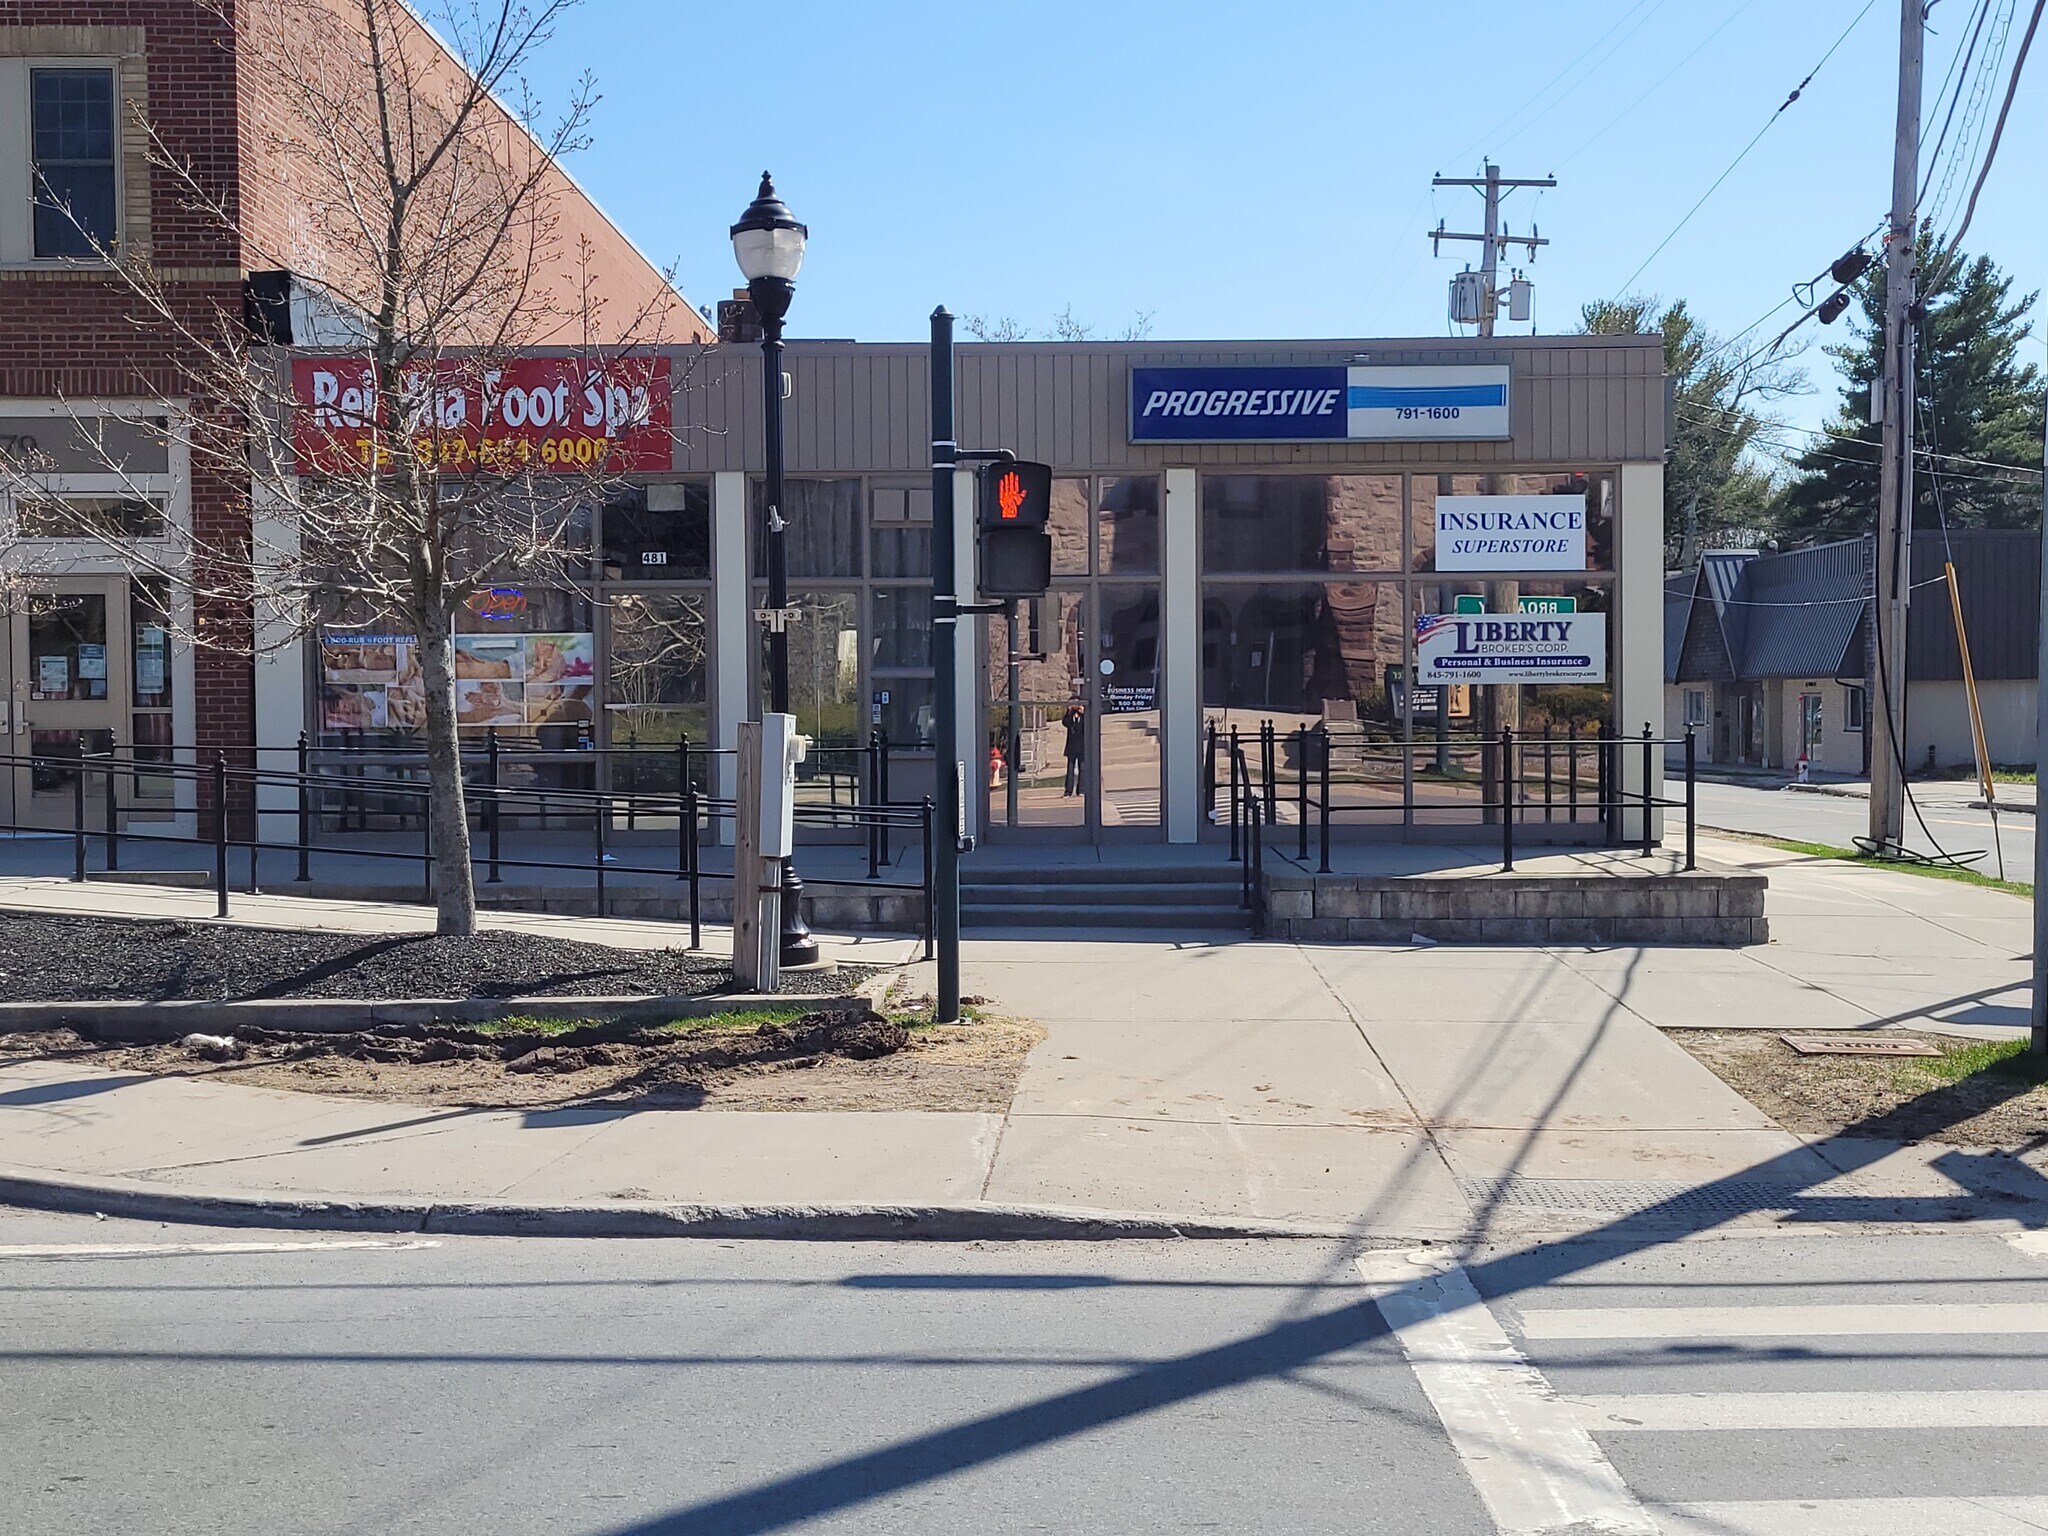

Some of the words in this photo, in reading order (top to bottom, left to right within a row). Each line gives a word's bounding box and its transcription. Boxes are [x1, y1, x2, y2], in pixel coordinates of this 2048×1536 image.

[1142, 389, 1341, 417] PROGRESSIVE
[1396, 406, 1460, 420] 791-1600
[1439, 511, 1583, 532] INSURANCE
[1452, 538, 1570, 555] SUPERSTORE
[643, 553, 664, 563] 481
[373, 636, 393, 644] FOOT
[1454, 621, 1573, 653] LIBERTY
[1481, 643, 1534, 653] BROKER'S
[1536, 643, 1568, 653] CORP.
[1441, 657, 1482, 667] Personal
[1484, 657, 1491, 667] &
[1494, 657, 1535, 667] Business
[1537, 657, 1583, 667] Insurance
[1427, 670, 1482, 679] 845-791-1600
